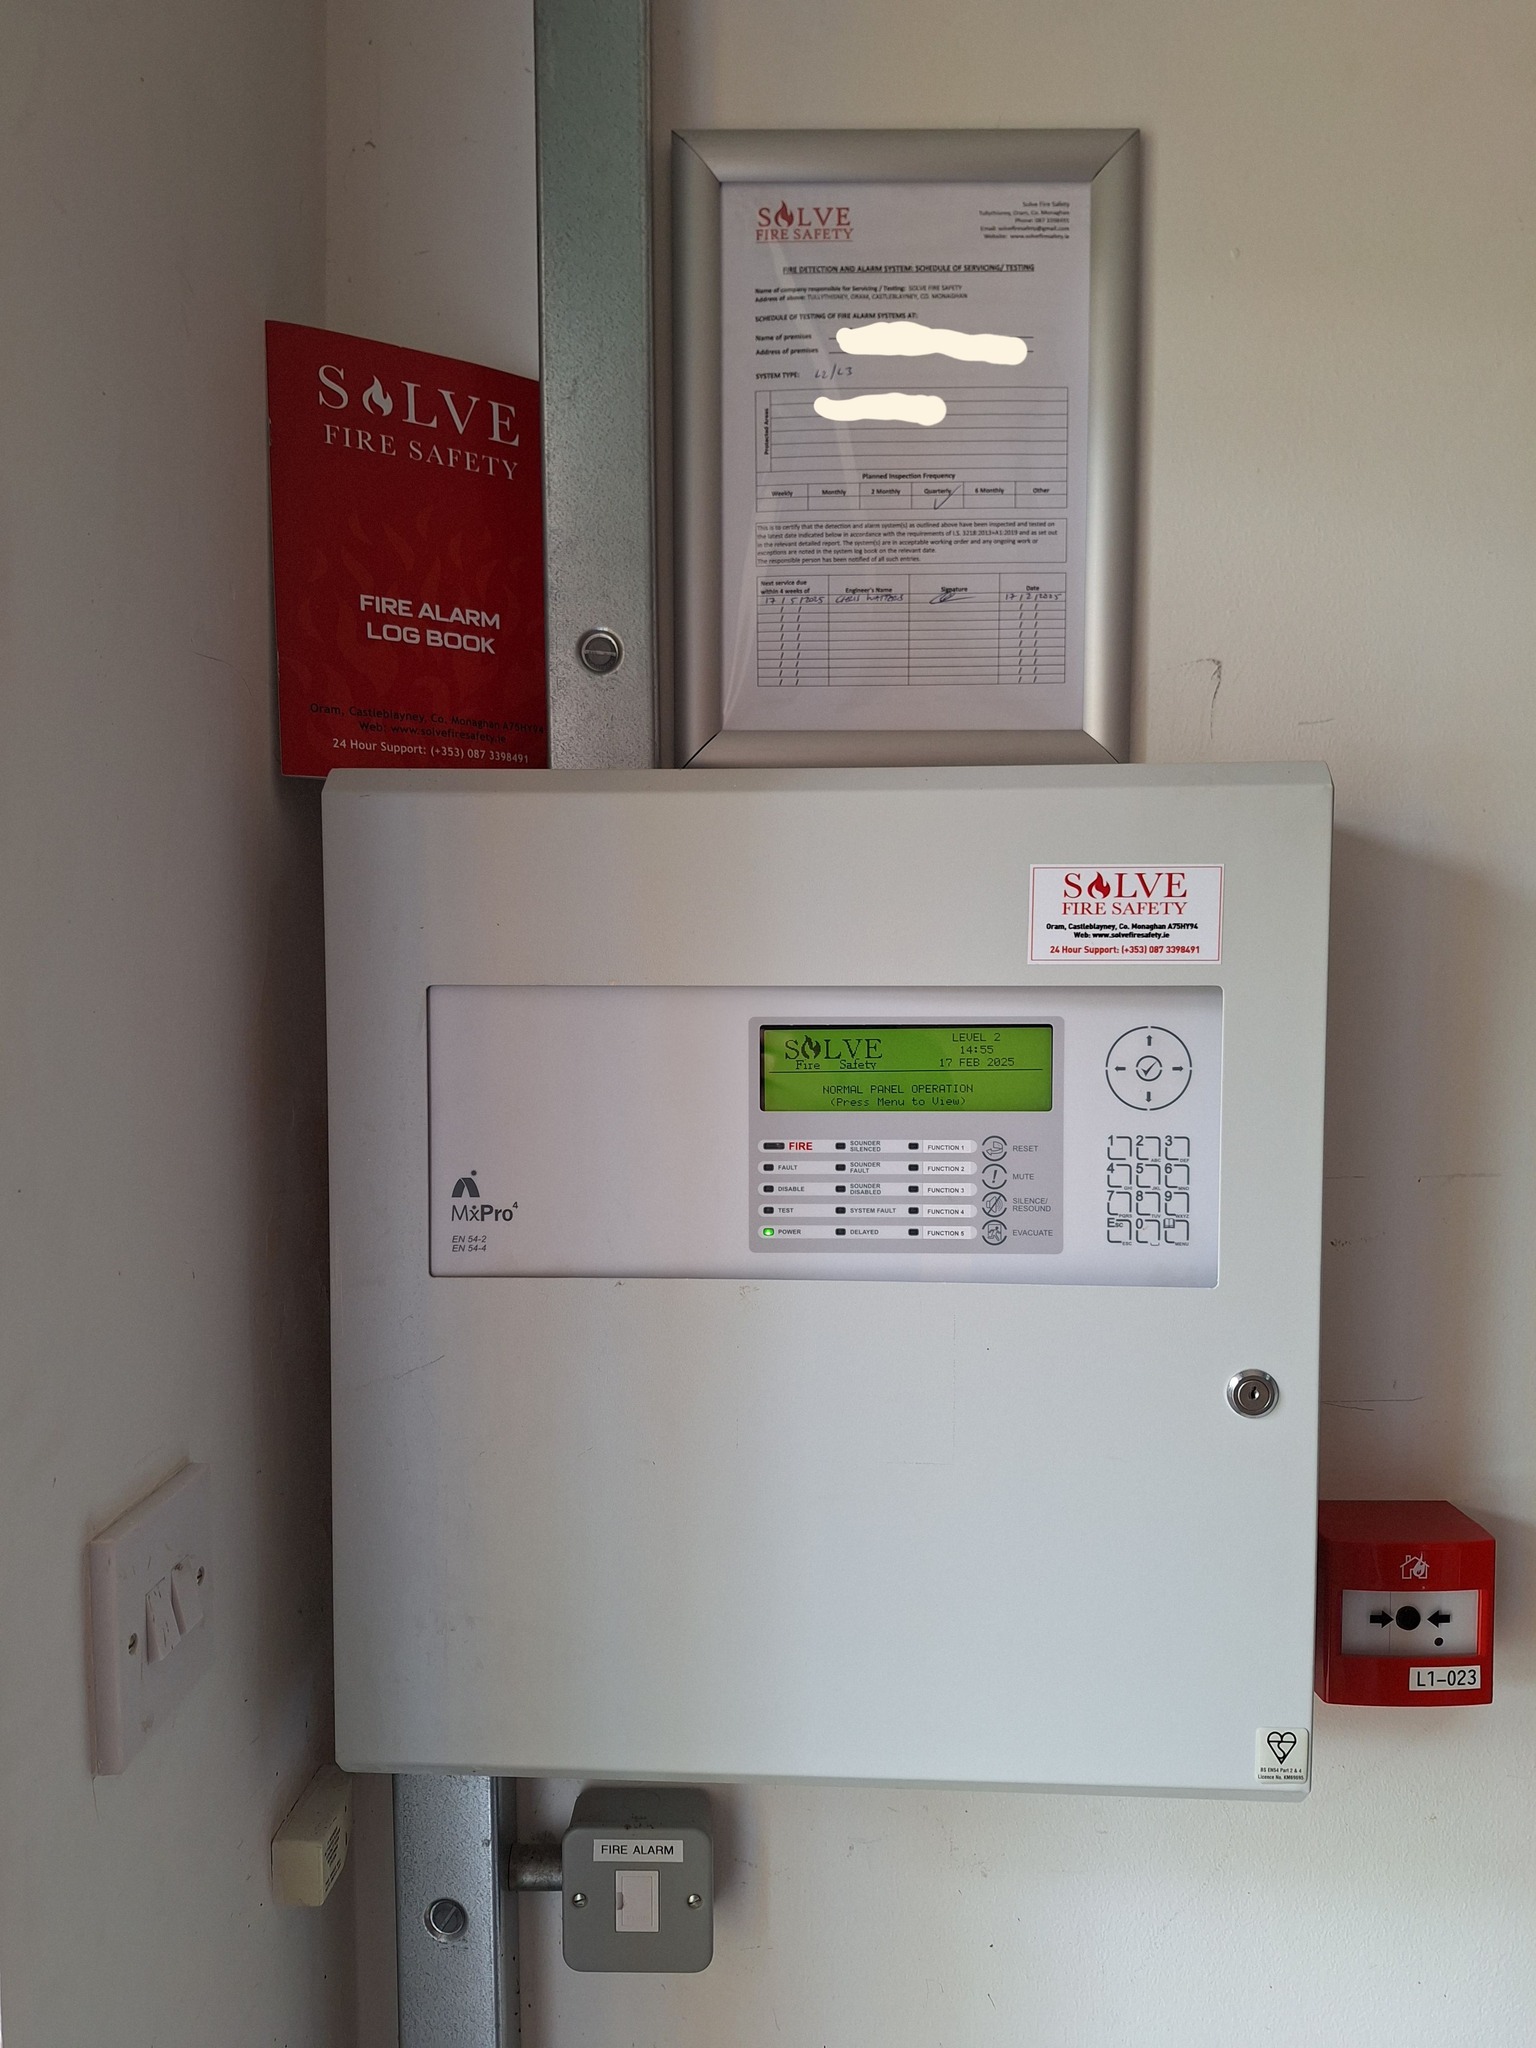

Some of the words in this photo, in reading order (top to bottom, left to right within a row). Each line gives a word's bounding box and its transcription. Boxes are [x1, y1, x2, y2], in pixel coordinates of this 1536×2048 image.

[755, 228, 790, 241] FIRE
[793, 228, 854, 241] SAFETY
[799, 265, 838, 273] DETECTION
[840, 265, 856, 273] AND
[857, 265, 882, 273] ALARM
[915, 264, 951, 272] SCHEDULE
[952, 264, 962, 272] OF
[1006, 264, 1035, 272] TESTING
[324, 424, 396, 456] FIRE
[409, 440, 518, 481] SAFETY
[771, 490, 793, 498] Weekly
[876, 488, 901, 496] Monthly
[360, 594, 413, 617] FIRE
[418, 603, 500, 630] ALARM
[366, 622, 420, 644] LOG
[426, 630, 496, 654] BOOK
[332, 738, 347, 750] 24
[350, 740, 378, 752] Hour
[380, 742, 427, 756] Support:
[430, 746, 464, 759] (+353)
[467, 749, 486, 760] 087
[489, 751, 529, 764] 3398491
[1061, 902, 1107, 916] FIRE
[1112, 902, 1188, 916] SAFETY
[1068, 923, 1118, 932] Castleblayney,
[1132, 923, 1166, 932] Monaghan
[1092, 932, 1170, 940] www.solvefiresafety.ie
[1050, 946, 1060, 954] 24
[1062, 946, 1082, 954] Hour
[1084, 946, 1120, 955] Support:
[1121, 946, 1147, 954] (+353)
[1149, 946, 1163, 954] 087
[1165, 945, 1200, 954] 3398491
[952, 1033, 986, 1042] LEVEL
[993, 1033, 1001, 1042] 2
[960, 1045, 994, 1054] 14:55
[796, 1060, 820, 1070] Fire
[839, 1060, 878, 1070] Safety
[939, 1058, 952, 1067] 17
[959, 1058, 981, 1067] FEB
[986, 1058, 1015, 1067] 2025
[822, 1084, 864, 1094] NORMAL
[870, 1084, 904, 1094] PANEL
[911, 1084, 974, 1094] OPERATION
[830, 1097, 870, 1107] (Press
[878, 1097, 905, 1107] Menu
[912, 1097, 926, 1107] to
[932, 1097, 966, 1107] View)
[1107, 1135, 1114, 1146] 1
[1136, 1135, 1144, 1146] 2
[1165, 1135, 1173, 1147] 3
[788, 1142, 813, 1151] FIRE
[1106, 1163, 1114, 1173] 4
[1136, 1163, 1144, 1174] 5
[1165, 1163, 1172, 1174] 6
[1107, 1190, 1114, 1201] 7
[1136, 1190, 1143, 1201] 8
[1165, 1191, 1172, 1202] 9
[1136, 1218, 1143, 1229] 0
[452, 1235, 466, 1243] EN
[468, 1235, 487, 1243] 54-2
[452, 1244, 466, 1252] EN
[468, 1244, 487, 1252] 54-4
[1416, 1669, 1477, 1687] L1-023
[601, 1845, 628, 1854] FIRE
[632, 1845, 674, 1855] ALARM
